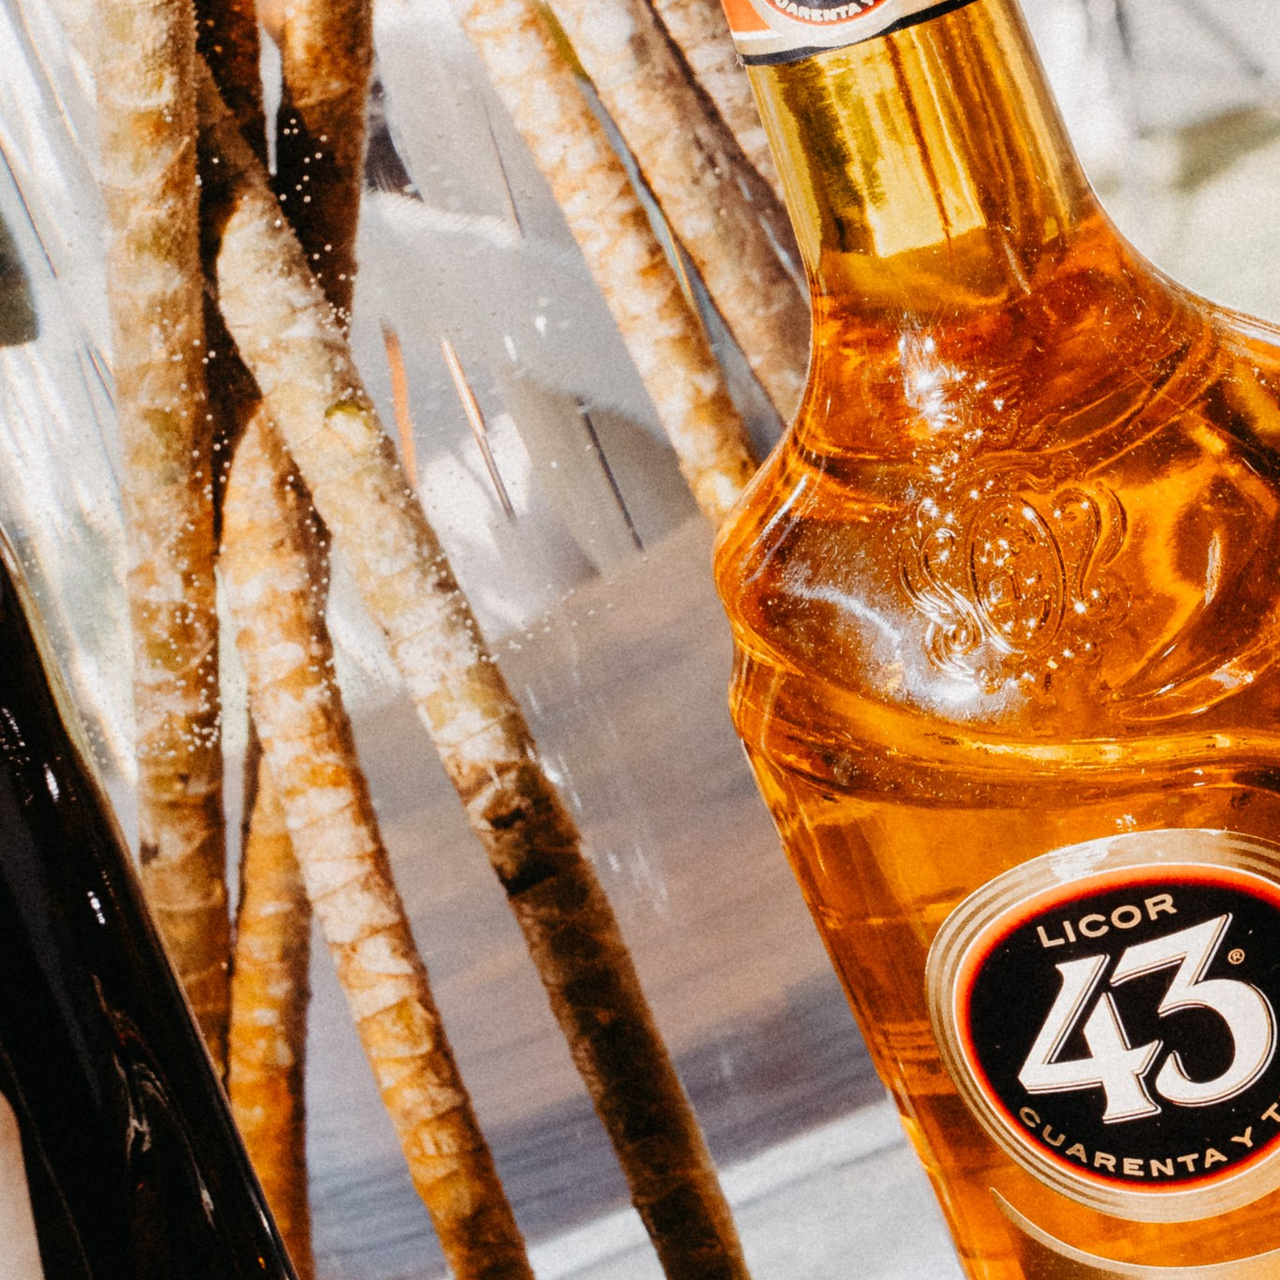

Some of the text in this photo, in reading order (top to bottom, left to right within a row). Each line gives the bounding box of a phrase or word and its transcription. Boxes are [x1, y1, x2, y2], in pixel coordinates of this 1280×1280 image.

[1036, 892, 1179, 949] LICOR
[1017, 911, 1279, 1125] 43
[1017, 1105, 1229, 1178] CUARENTA
[1231, 1125, 1256, 1150] Y
